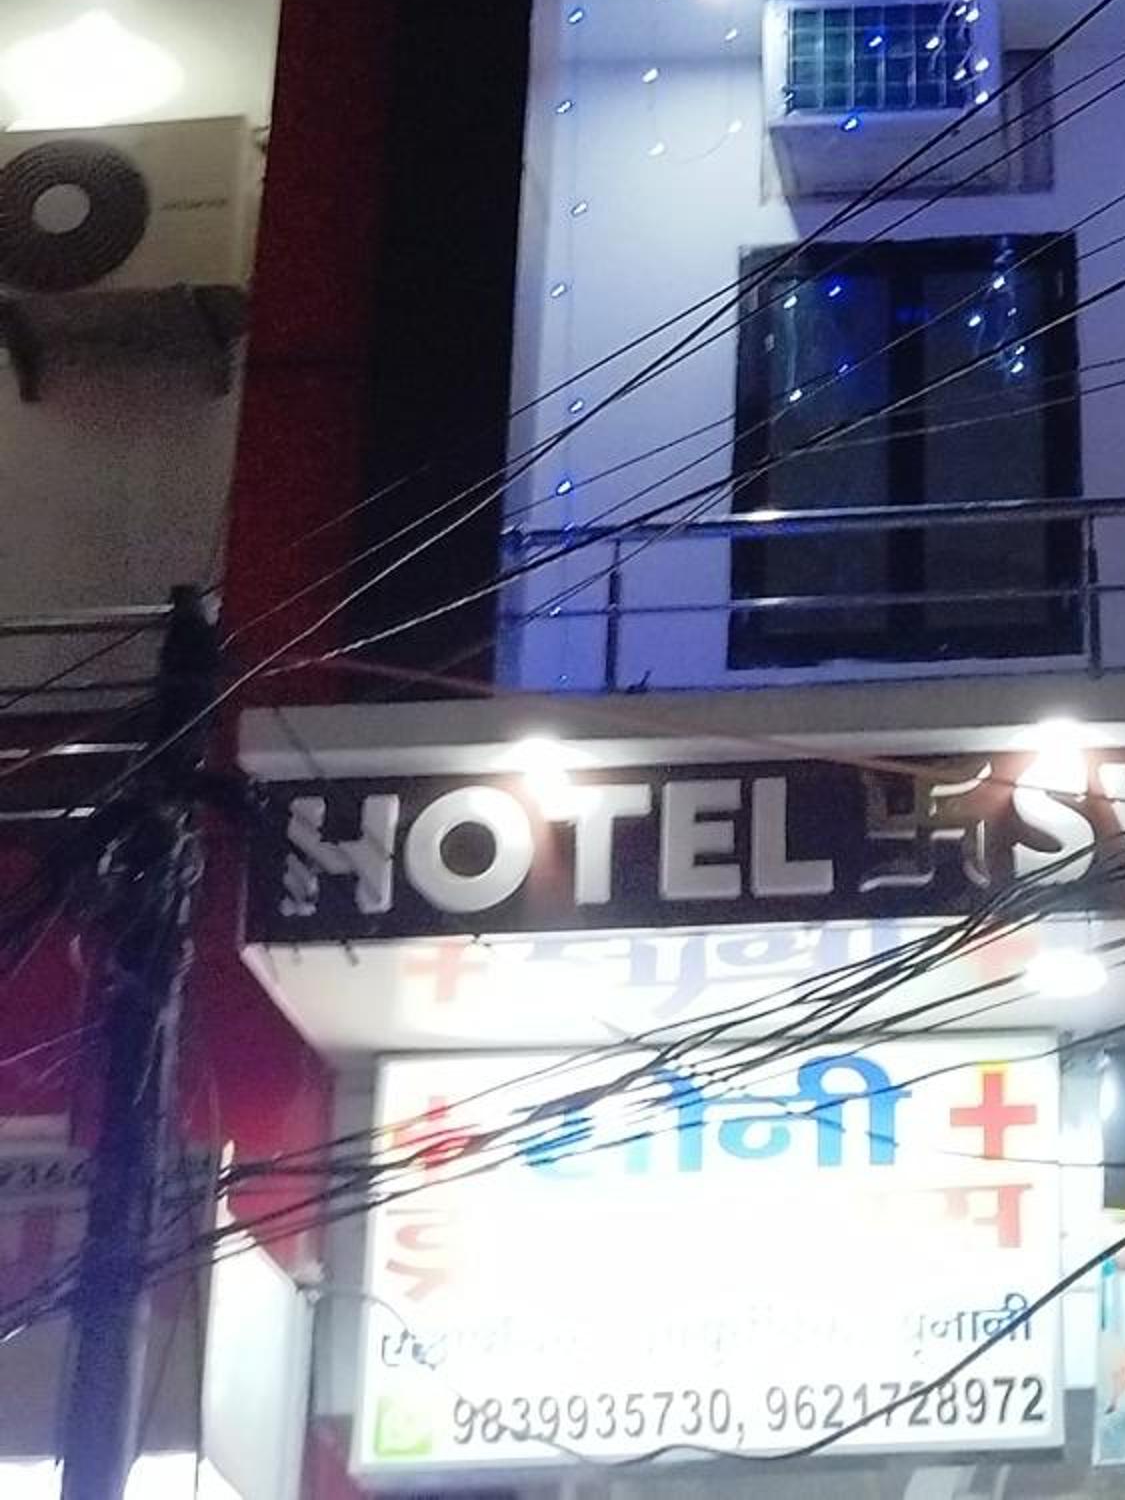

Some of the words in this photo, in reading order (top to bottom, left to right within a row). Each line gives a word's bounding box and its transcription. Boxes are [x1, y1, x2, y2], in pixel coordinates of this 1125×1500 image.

[281, 777, 834, 916] HOTEL
[452, 1388, 745, 1446] 9839935730,
[766, 1376, 1044, 1432] 9621728972
